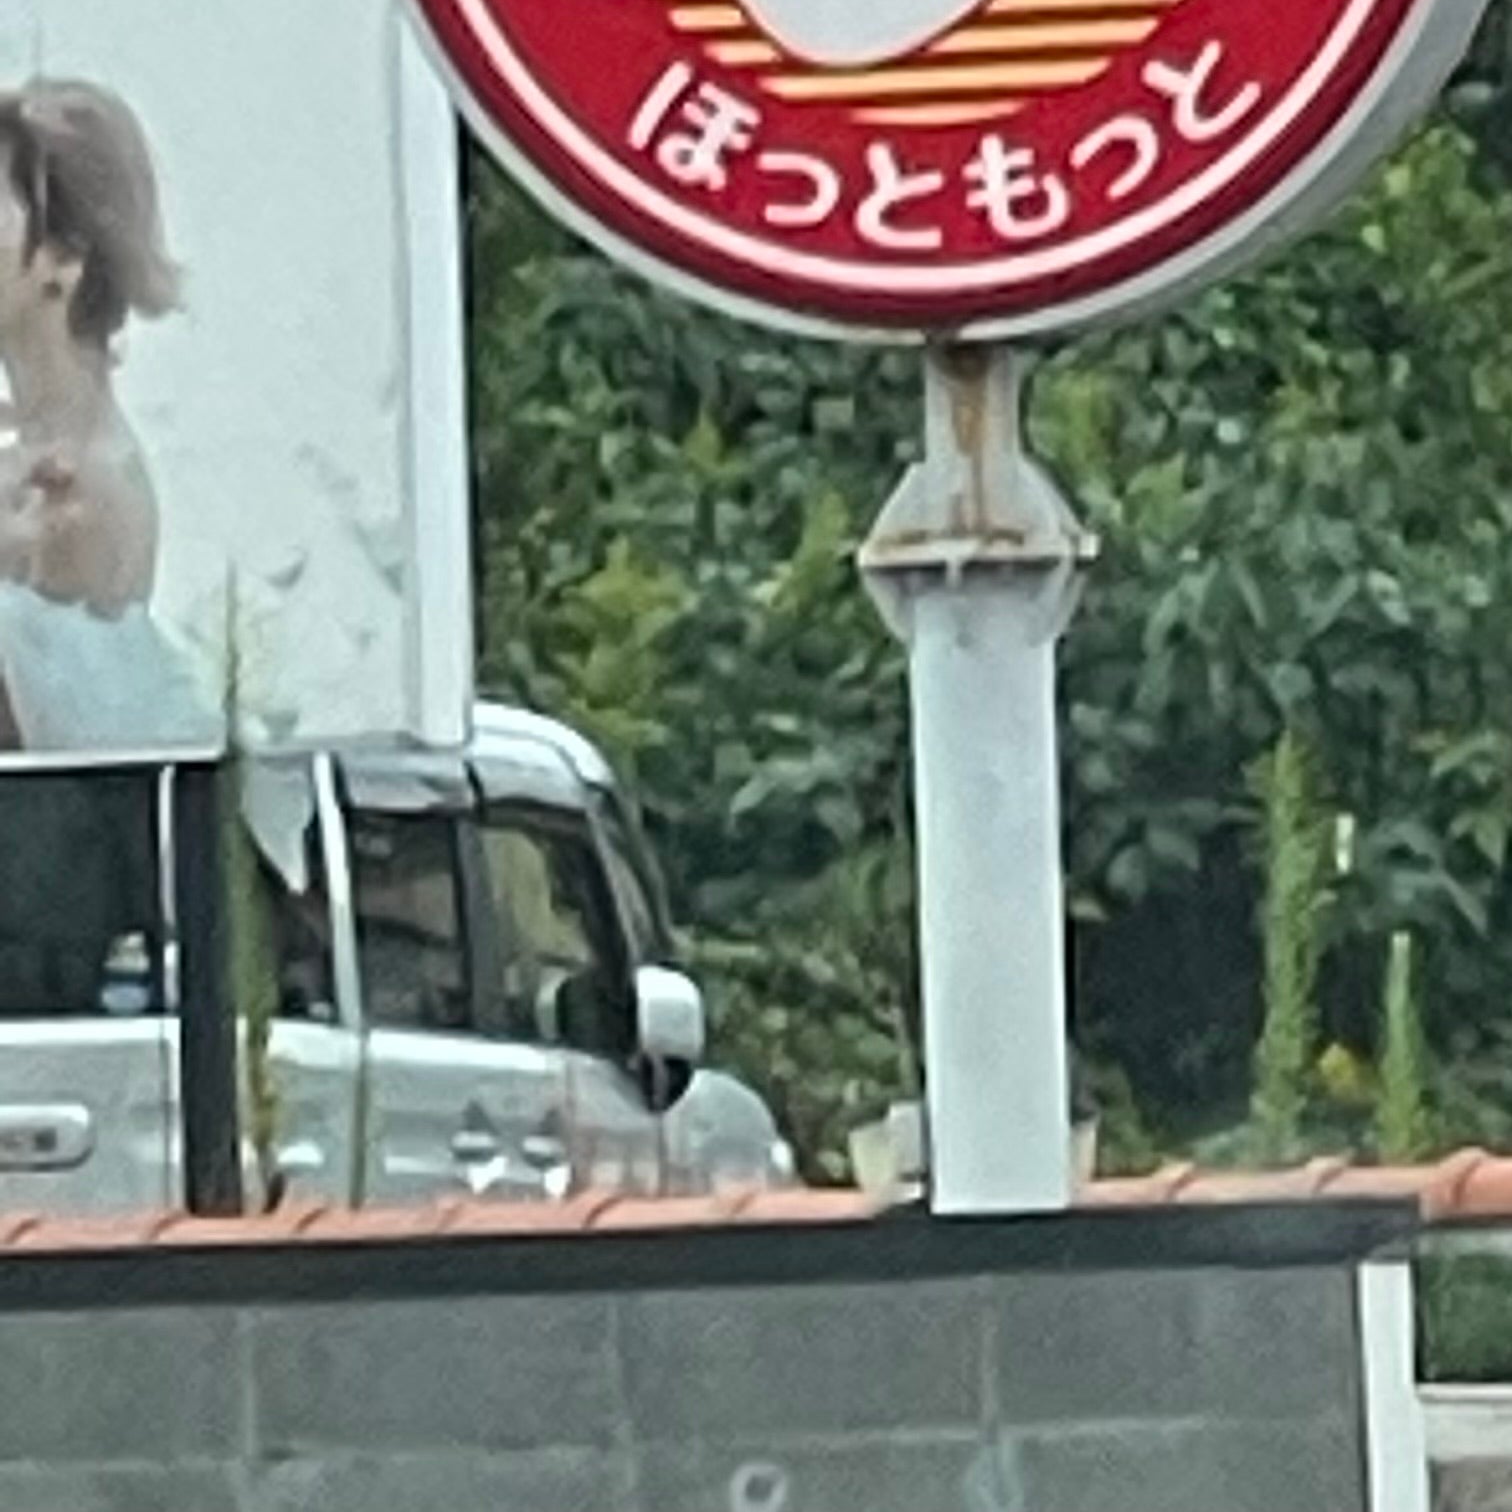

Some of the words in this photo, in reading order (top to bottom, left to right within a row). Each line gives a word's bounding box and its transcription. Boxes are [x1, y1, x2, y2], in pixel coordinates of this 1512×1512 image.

[632, 44, 1258, 245] ほっともっと
